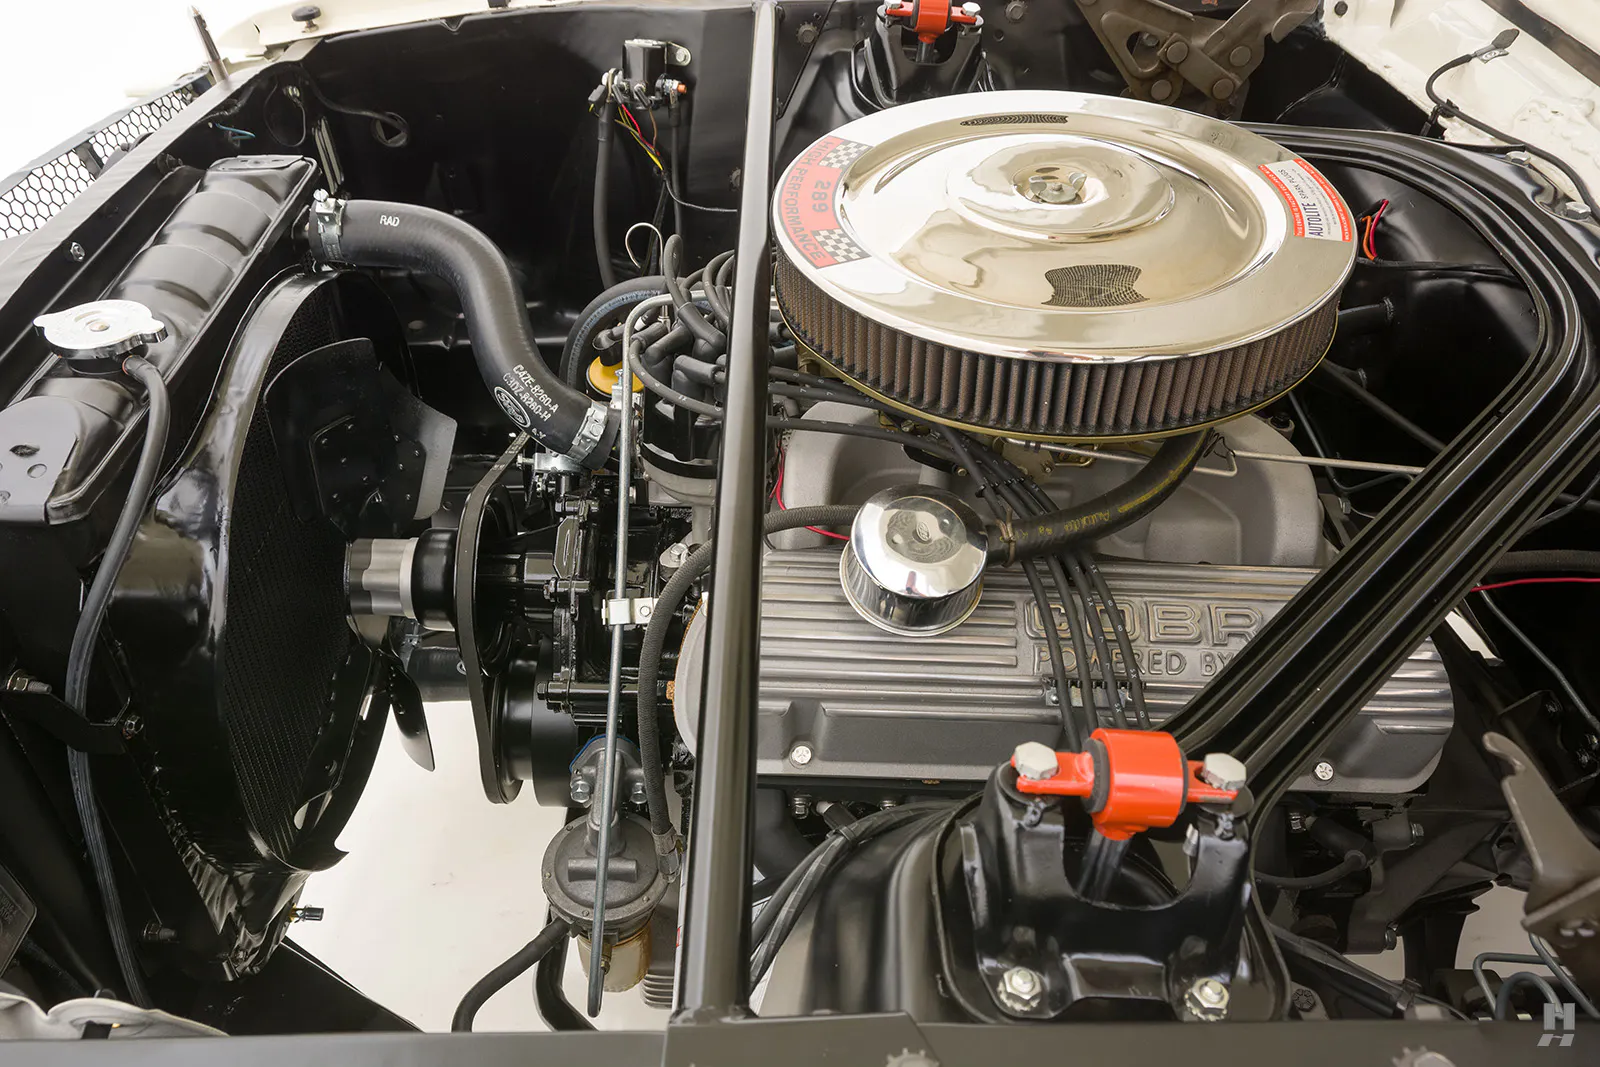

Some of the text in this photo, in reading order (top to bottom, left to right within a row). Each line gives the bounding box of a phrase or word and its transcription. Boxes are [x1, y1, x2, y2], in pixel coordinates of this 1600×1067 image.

[1278, 169, 1295, 183] PLUGS
[784, 140, 834, 261] HIGH PERFORMANCE
[811, 180, 832, 213] 289
[380, 214, 400, 227] RAD
[1301, 203, 1323, 237] AUTOLITE
[502, 372, 552, 421] C3DZ-8260-H
[512, 364, 559, 413] C4ZE-8260-A
[1025, 600, 1263, 645] COBR
